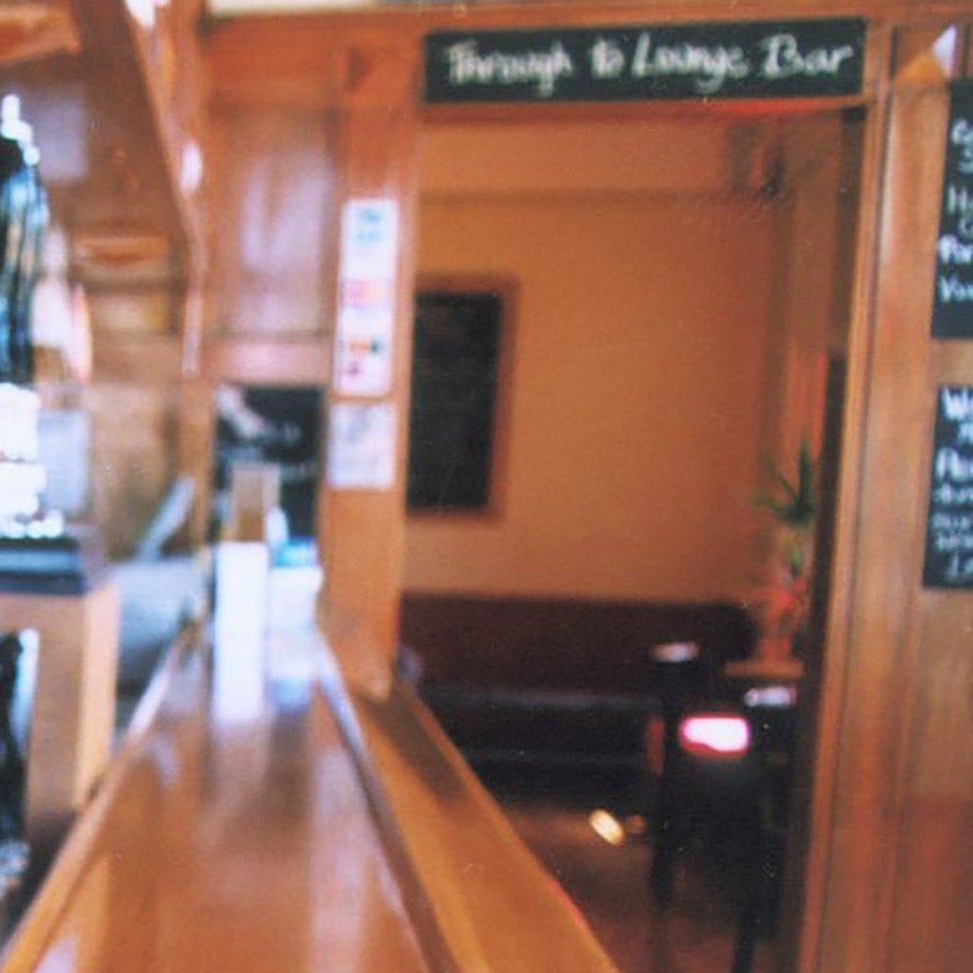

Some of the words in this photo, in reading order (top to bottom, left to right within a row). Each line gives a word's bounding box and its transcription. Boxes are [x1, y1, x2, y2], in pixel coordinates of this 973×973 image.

[444, 38, 572, 97] Through
[591, 33, 624, 79] to
[630, 31, 750, 94] Lounge
[758, 33, 854, 81] Bar
